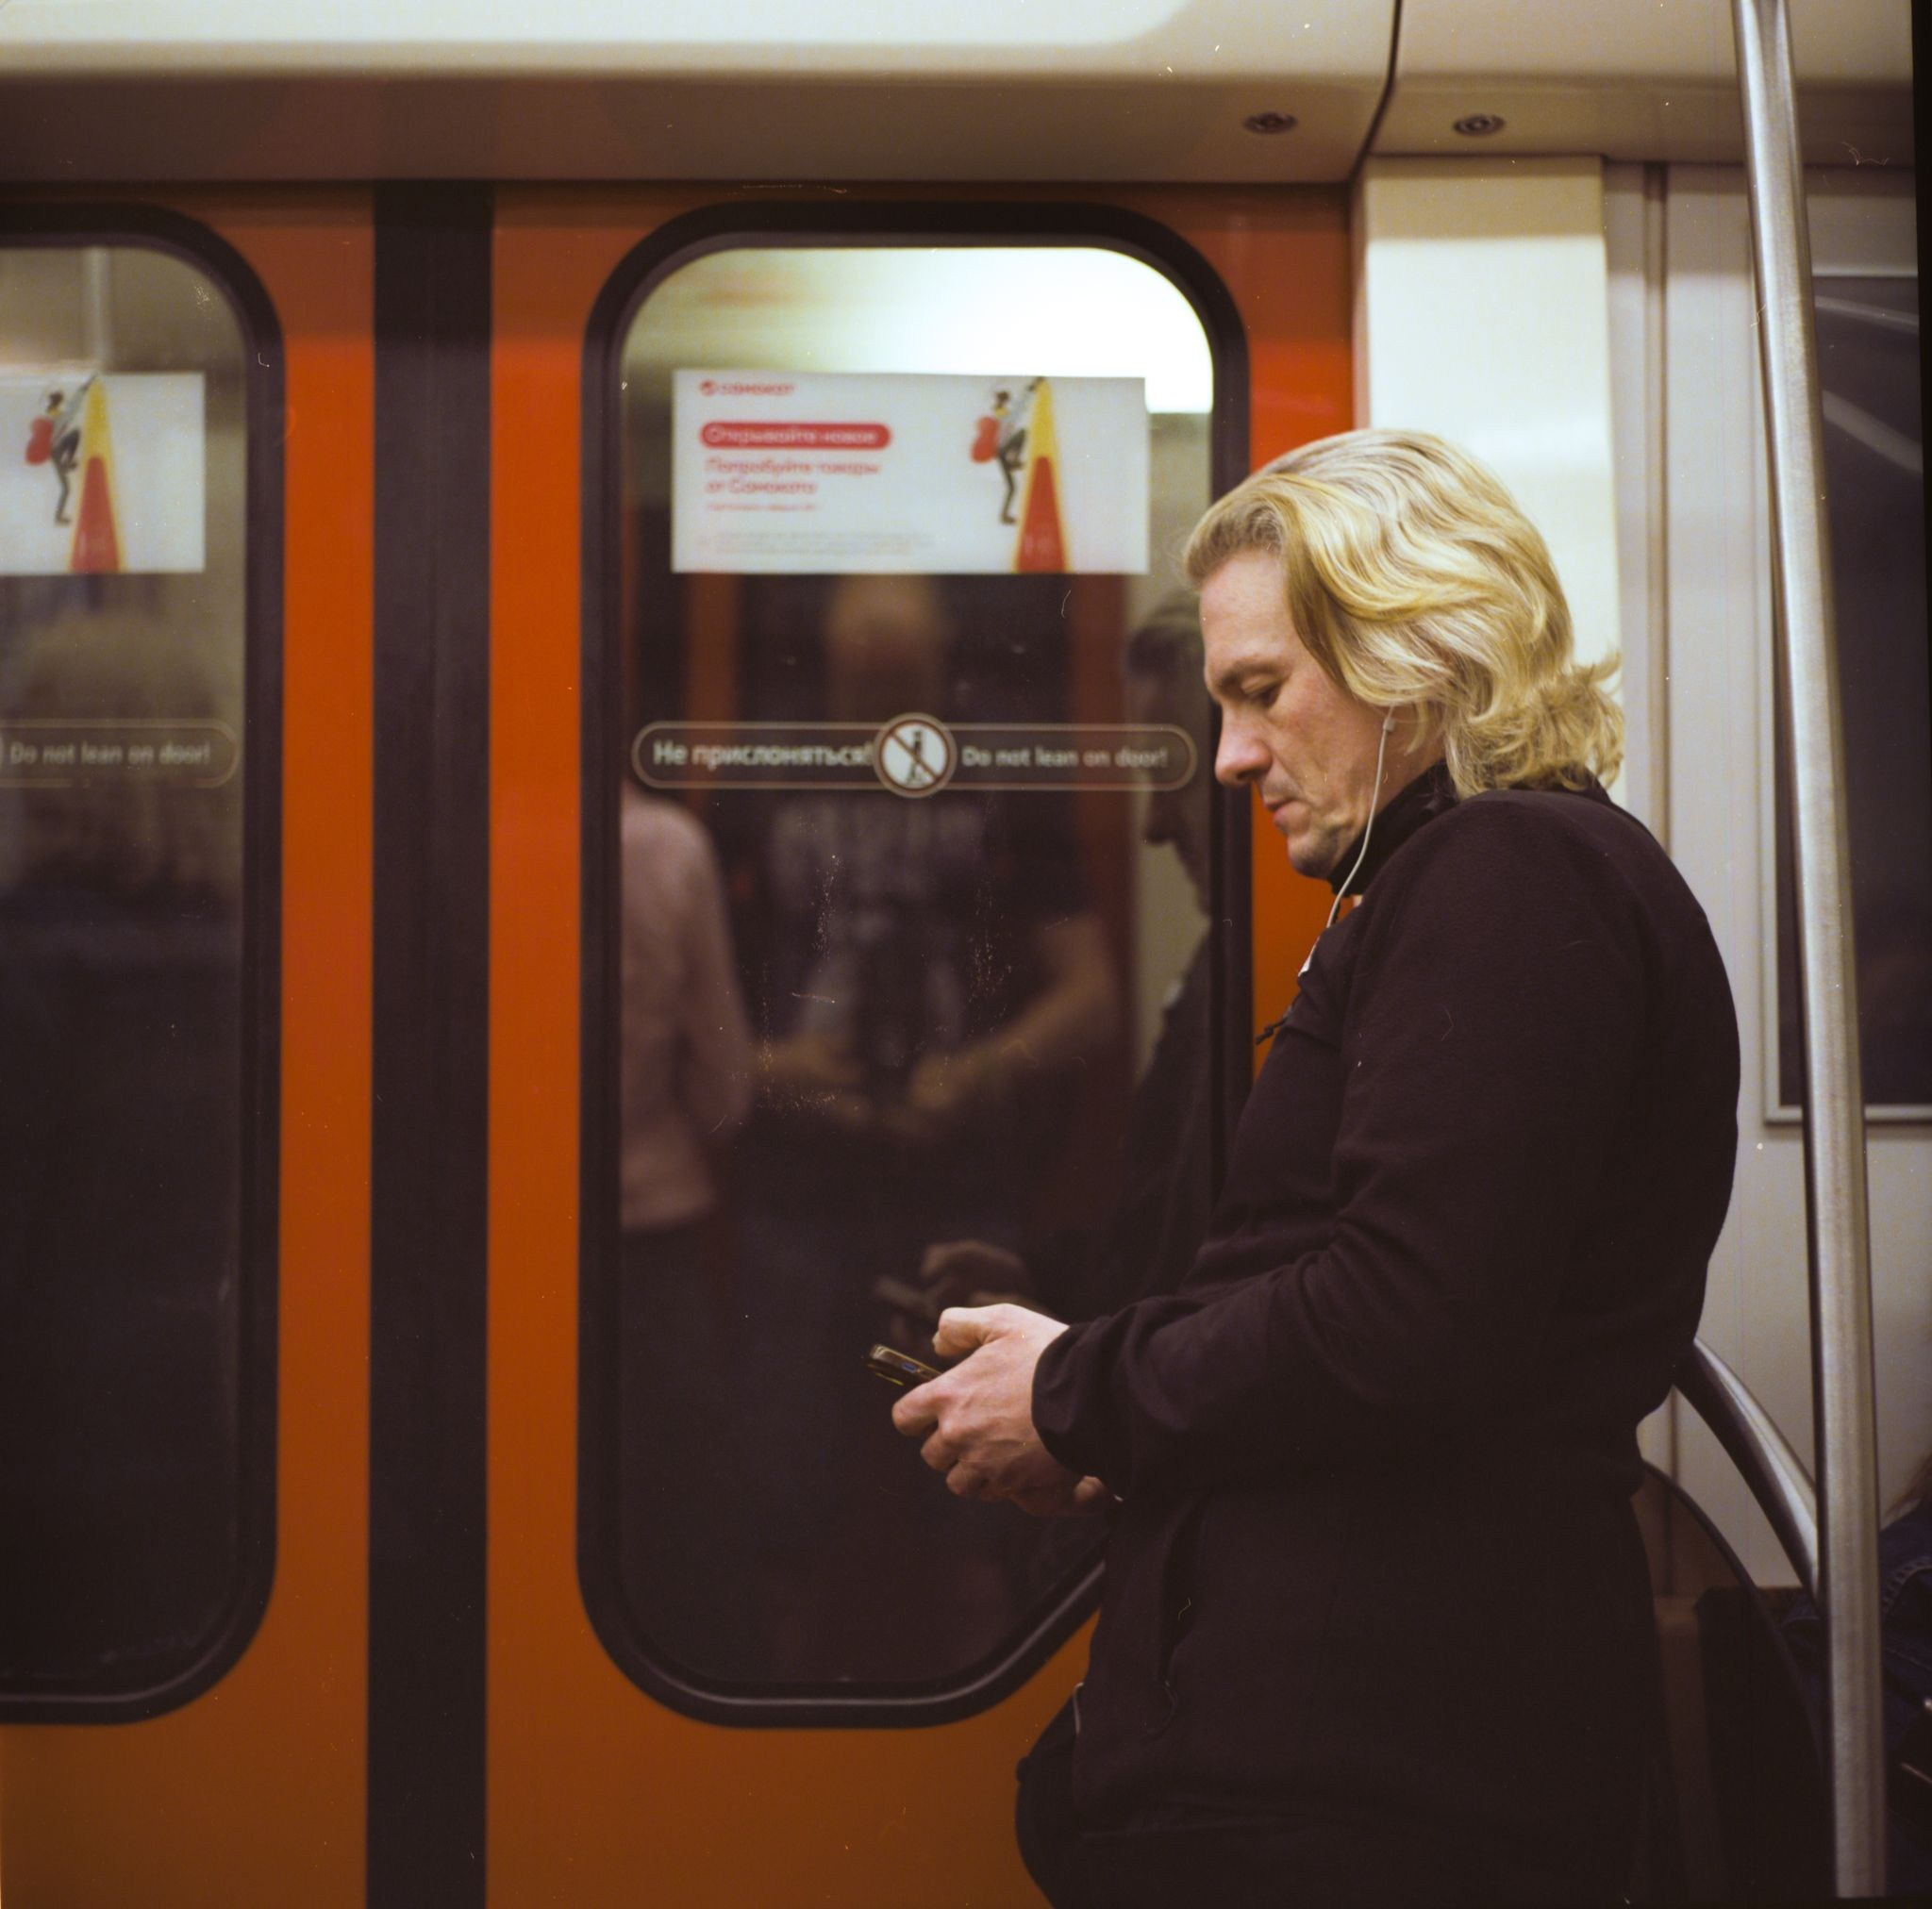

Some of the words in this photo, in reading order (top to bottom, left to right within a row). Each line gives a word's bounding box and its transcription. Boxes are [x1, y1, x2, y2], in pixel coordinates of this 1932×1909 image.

[707, 424, 816, 446] Открывайте
[824, 430, 877, 443] новое
[9, 741, 37, 765] Do
[43, 744, 75, 765] not
[80, 740, 123, 765] lean
[128, 744, 154, 765] on
[158, 741, 210, 765] door!
[653, 740, 689, 765] Не
[691, 741, 874, 771] прислоняться!
[961, 746, 991, 767] Do
[995, 749, 1030, 768] not
[1035, 746, 1078, 768] lean
[1083, 750, 1110, 768] on
[1114, 746, 1168, 768] door!
